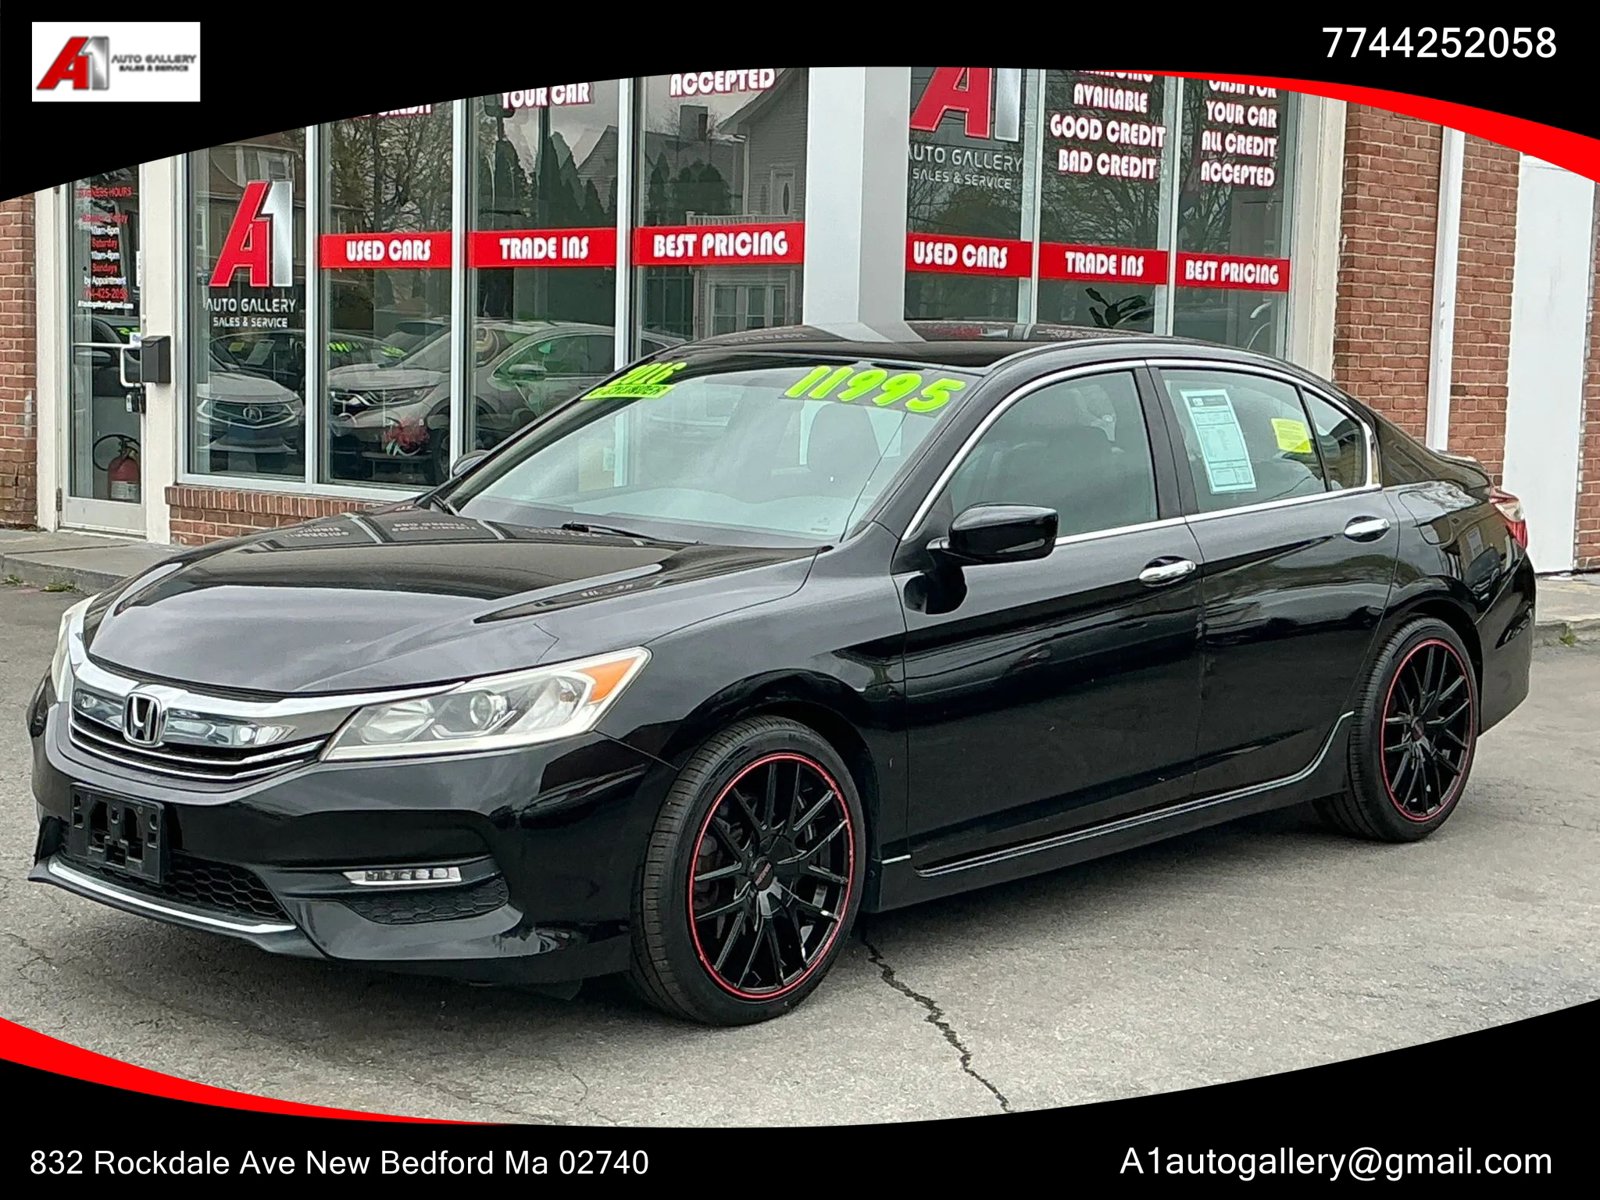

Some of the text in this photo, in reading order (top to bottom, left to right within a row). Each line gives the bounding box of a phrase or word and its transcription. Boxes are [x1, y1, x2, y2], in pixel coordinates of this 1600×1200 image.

[502, 83, 590, 109] YOUR CAR
[670, 69, 775, 97] ACCEPTED
[1073, 83, 1148, 113] AVAILABLE
[1205, 101, 1277, 128] YOUR CAR
[1050, 114, 1167, 147] GOOD CREDIT
[1201, 130, 1277, 157] ALL CREDIT
[908, 144, 1023, 172] AUTO GALLERY
[1058, 149, 1157, 179] BAD CREDIT
[913, 168, 1012, 190] SALES & SERVICE
[1201, 160, 1275, 187] ACCEPTED
[209, 181, 293, 287] A1
[500, 235, 589, 260] TRADE INS
[653, 231, 788, 257] BEST PRICING
[346, 239, 431, 262] USED CARS
[913, 241, 1008, 269] USED CARS
[1065, 251, 1144, 277] TRADE INS
[1185, 259, 1279, 285] BEST PRICING
[206, 298, 296, 312] AUTO GALLERY
[213, 316, 288, 328] SALES & SERVICE
[784, 365, 966, 412] 11995
